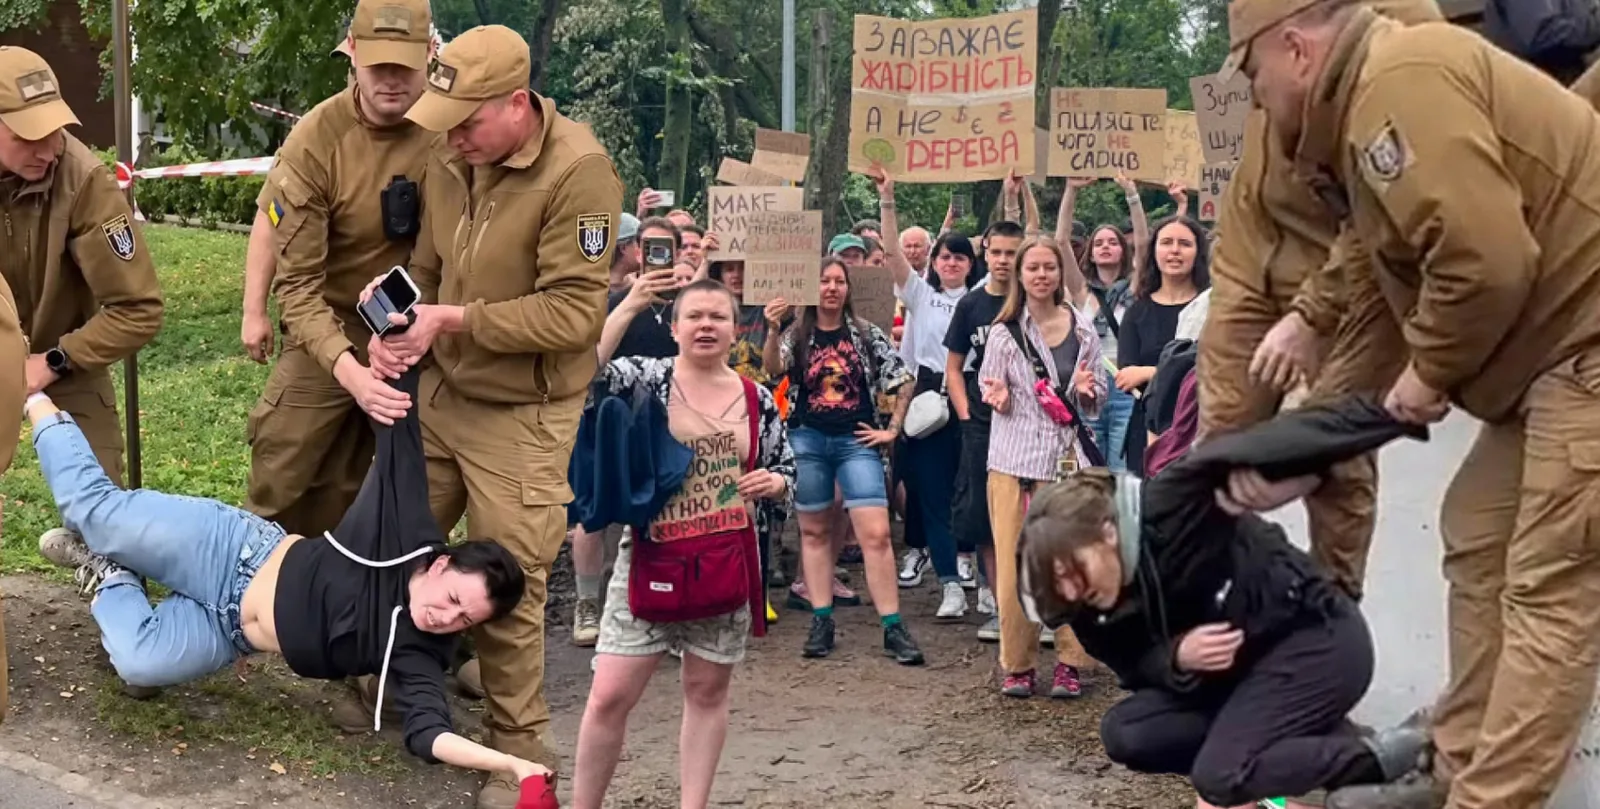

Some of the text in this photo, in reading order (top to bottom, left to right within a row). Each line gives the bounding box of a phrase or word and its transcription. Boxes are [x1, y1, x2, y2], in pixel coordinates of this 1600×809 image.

[864, 19, 1024, 59] ЗАВАЖАЄ
[860, 54, 1033, 92] ЖАДІБНІСТЬ
[1056, 91, 1081, 108] НЕ
[865, 106, 882, 133] А
[905, 130, 1019, 172] ДЕРЕВА
[1106, 132, 1131, 149] НЕ
[1070, 151, 1139, 170] САДИВ
[713, 192, 777, 215] MAKE
